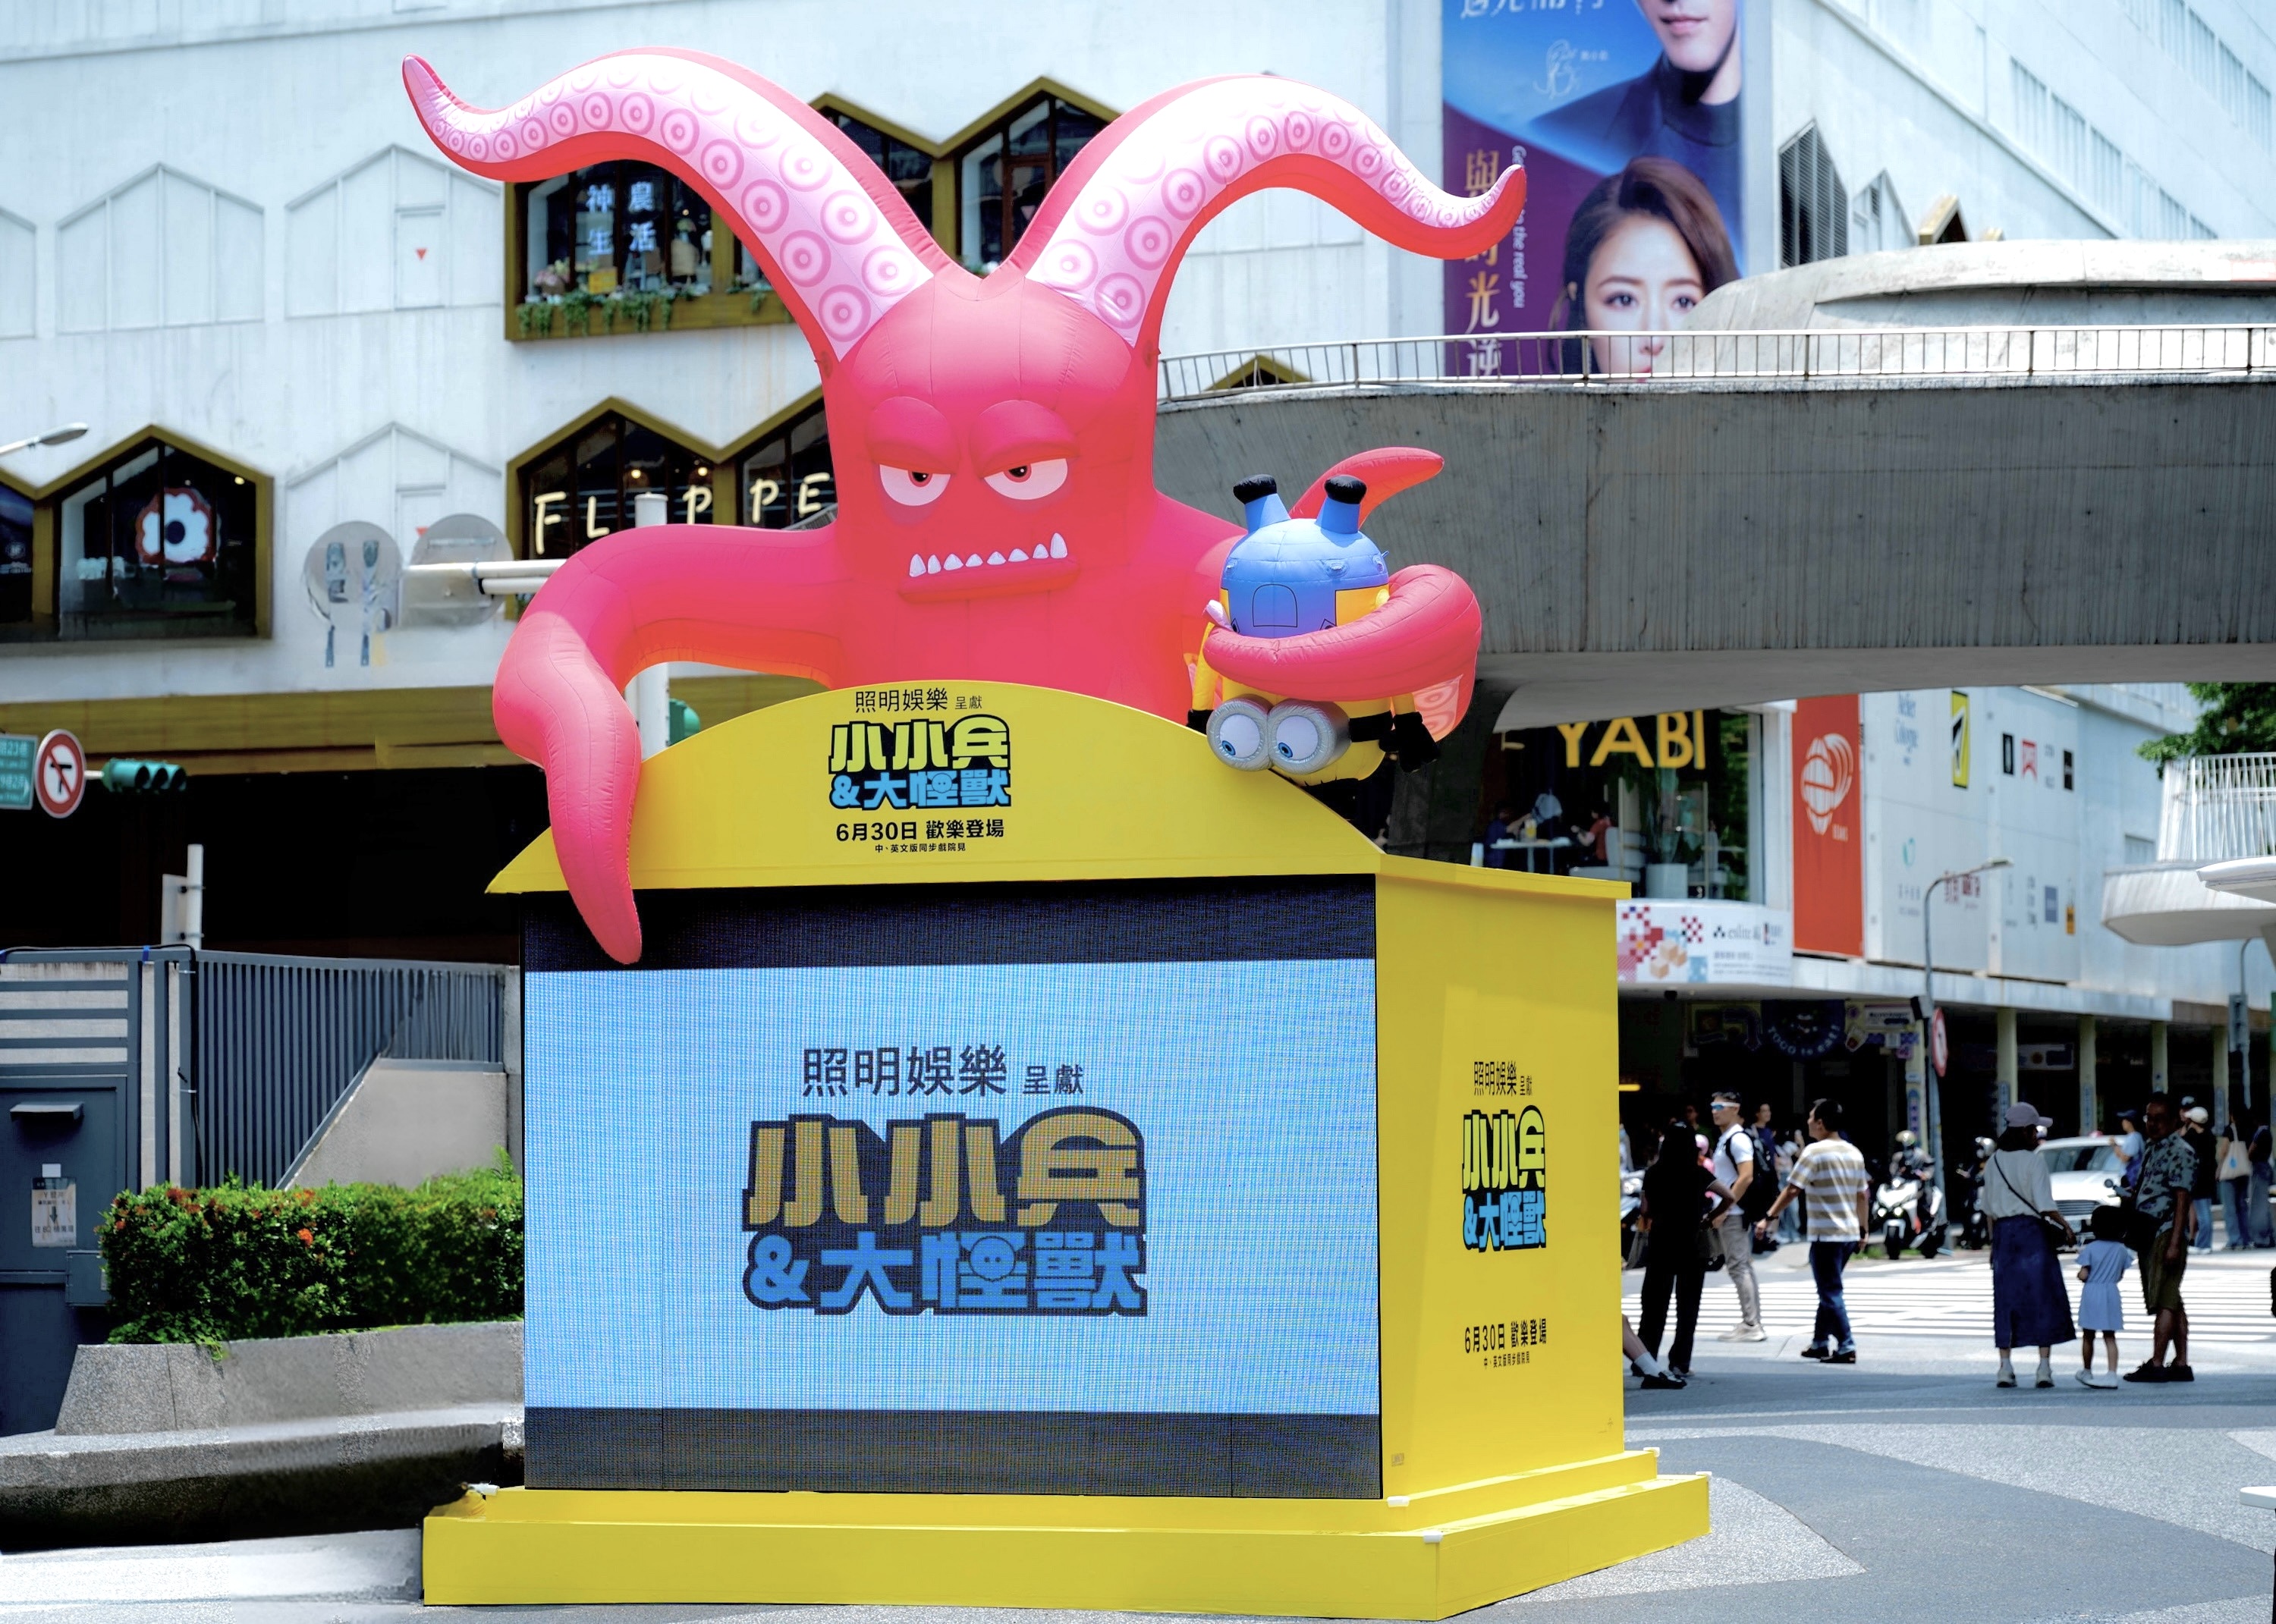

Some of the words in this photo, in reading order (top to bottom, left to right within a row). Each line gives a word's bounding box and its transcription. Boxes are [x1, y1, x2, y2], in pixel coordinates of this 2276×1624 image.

[586, 221, 656, 256] 生活
[1512, 226, 1528, 250] the
[1512, 251, 1528, 279] real
[1510, 280, 1526, 308] you
[534, 471, 830, 554] FLPPE
[855, 687, 948, 713] 照明娛樂
[954, 695, 982, 710] 呈獻
[828, 714, 1011, 774] 小小兵
[1557, 709, 1706, 770] YABI
[836, 821, 917, 842] 6月30日
[926, 818, 1004, 840] 歡樂登場
[874, 842, 967, 853] 中、英文版同步戲院見
[802, 1044, 1008, 1097] 照明娛樂
[1022, 1064, 1083, 1095] 呈獻
[1474, 1060, 1517, 1096] 照明娛樂
[1462, 1104, 1545, 1193] 小小兵
[742, 1106, 1146, 1231] 小小兵
[1465, 1324, 1505, 1353] 6月30日
[1511, 1318, 1547, 1347] 歡樂登場
